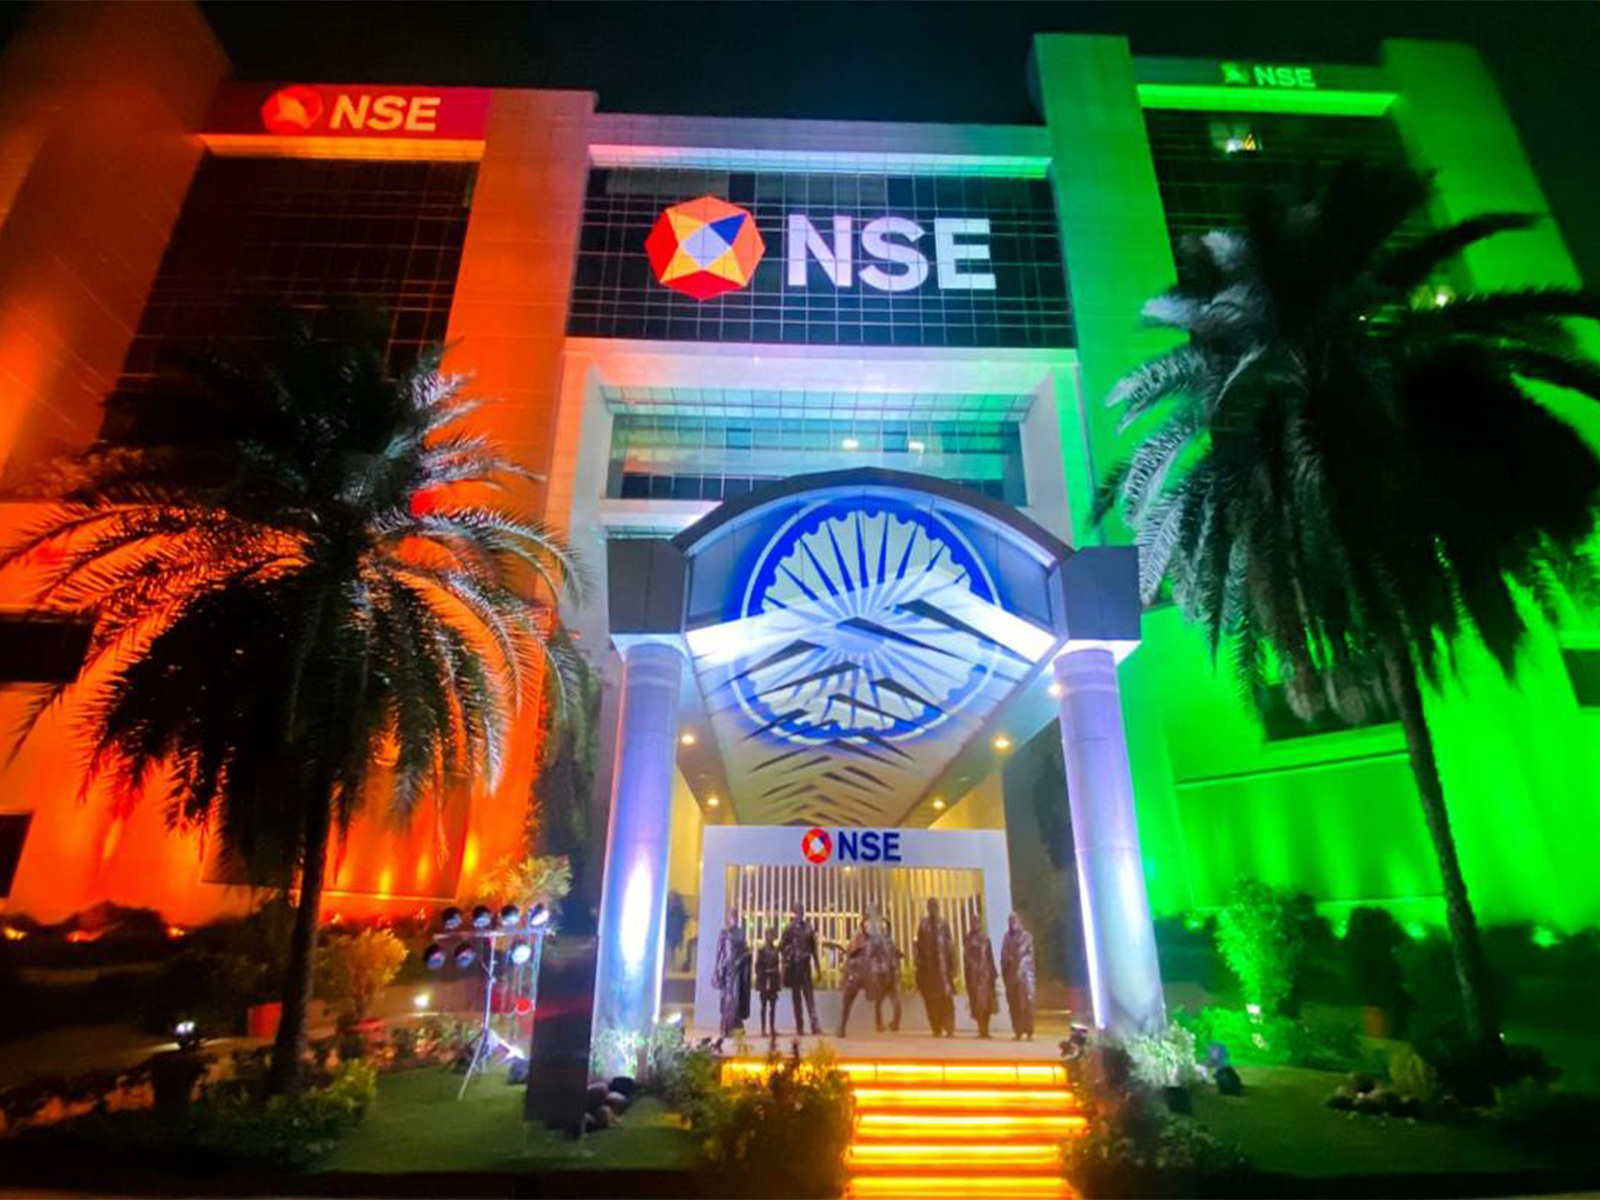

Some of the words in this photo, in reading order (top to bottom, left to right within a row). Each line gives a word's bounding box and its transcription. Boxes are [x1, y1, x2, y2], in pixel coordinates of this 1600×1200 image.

[1254, 66, 1316, 88] NSE
[328, 95, 441, 131] NSE
[788, 214, 996, 291] NSE
[838, 831, 902, 862] NSE
